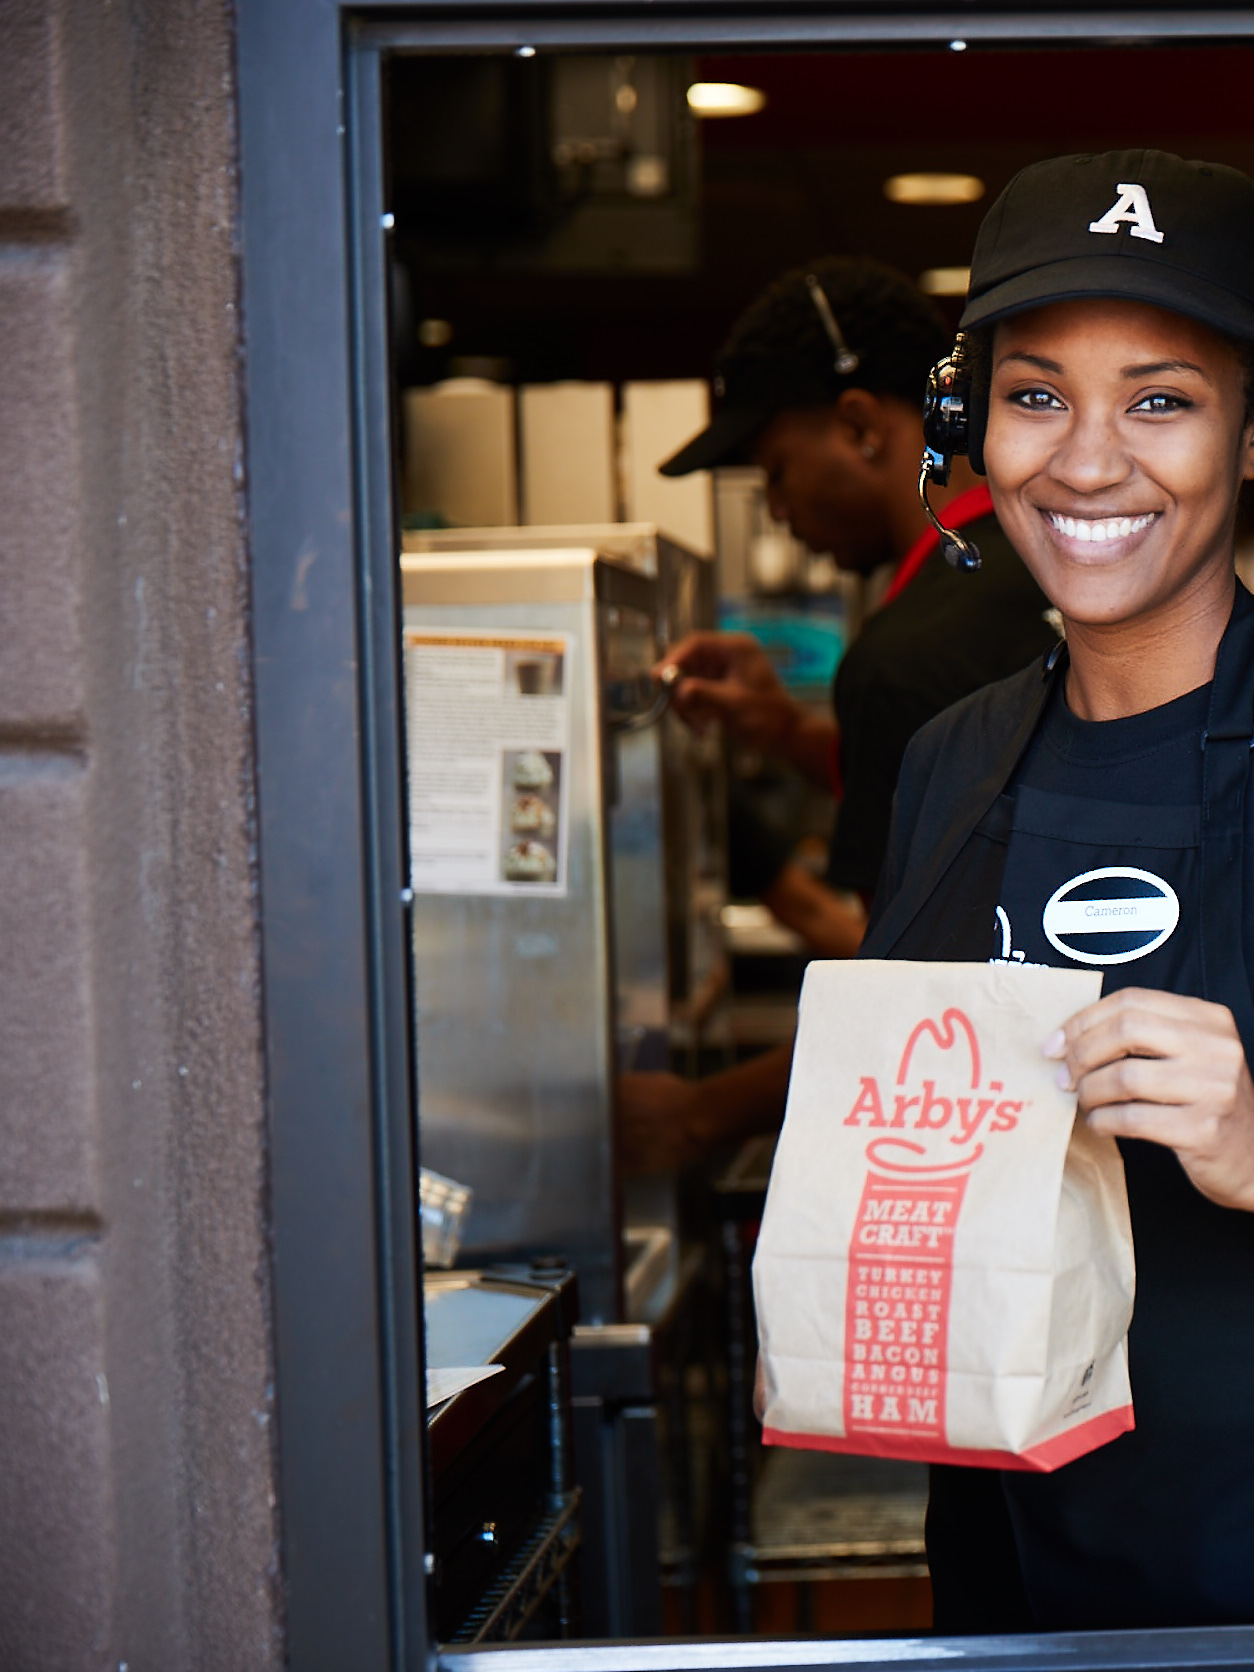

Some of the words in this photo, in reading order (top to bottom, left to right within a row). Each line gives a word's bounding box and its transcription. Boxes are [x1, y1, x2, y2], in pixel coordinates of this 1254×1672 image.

[1089, 183, 1164, 243] A
[1084, 905, 1138, 917] Cameron
[843, 1077, 1024, 1144] Arby's
[863, 1199, 953, 1223] MEAT
[858, 1265, 943, 1285] TURKEY
[855, 1283, 942, 1301] CHICKEN
[855, 1300, 941, 1320] ROAST
[855, 1318, 939, 1344] BEEF
[853, 1343, 939, 1365] BACON
[852, 1362, 939, 1384] ANGUS
[852, 1394, 938, 1424] HAM
